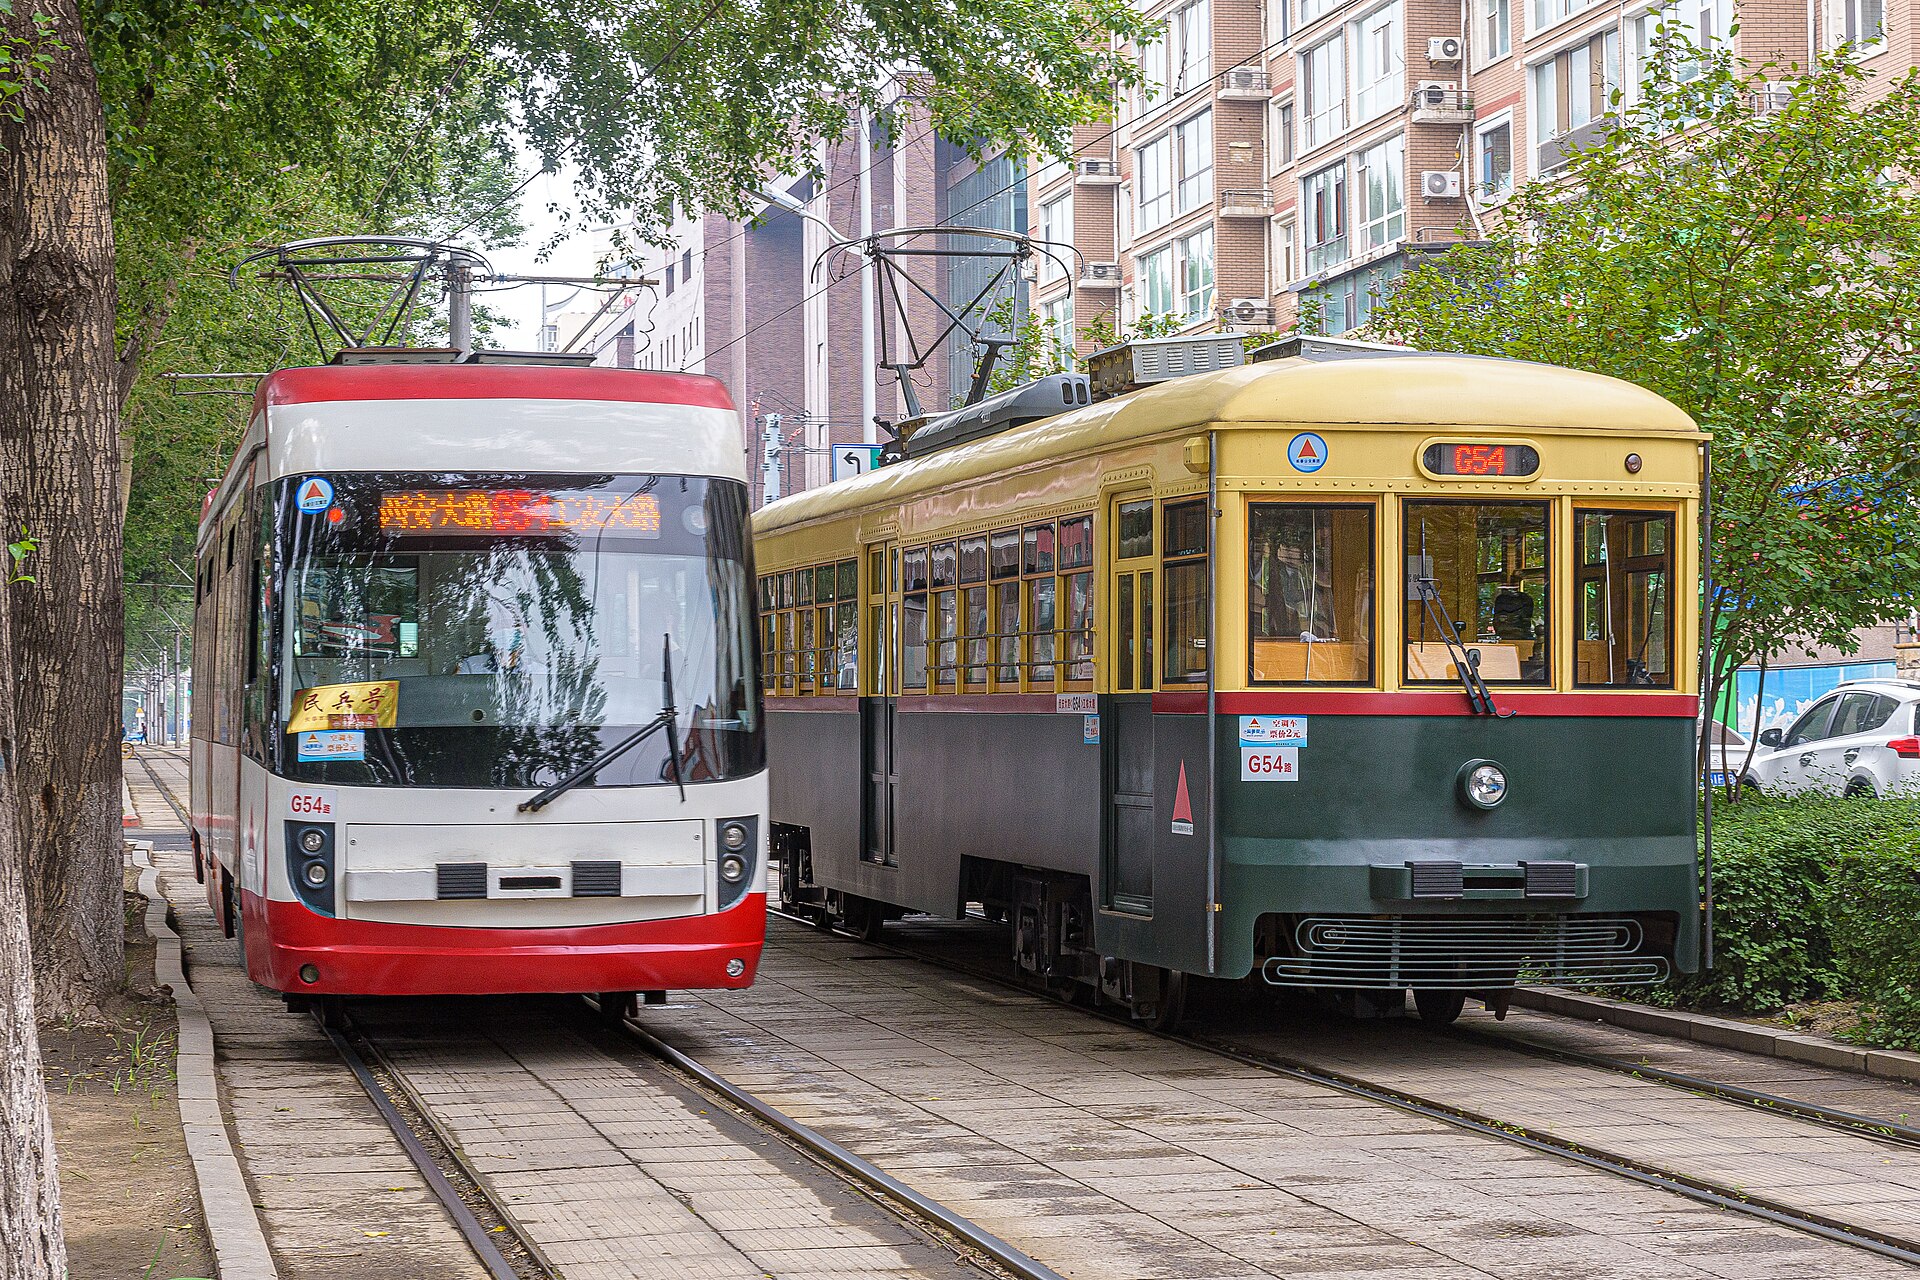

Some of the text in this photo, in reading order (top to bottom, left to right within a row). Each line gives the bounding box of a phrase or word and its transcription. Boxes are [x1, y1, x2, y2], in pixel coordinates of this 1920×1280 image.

[1455, 446, 1505, 474] G54
[303, 687, 385, 712] 民兵号
[1272, 719, 1298, 728] 空调车
[1269, 728, 1301, 738] 票价2元
[1248, 755, 1292, 773] G54路
